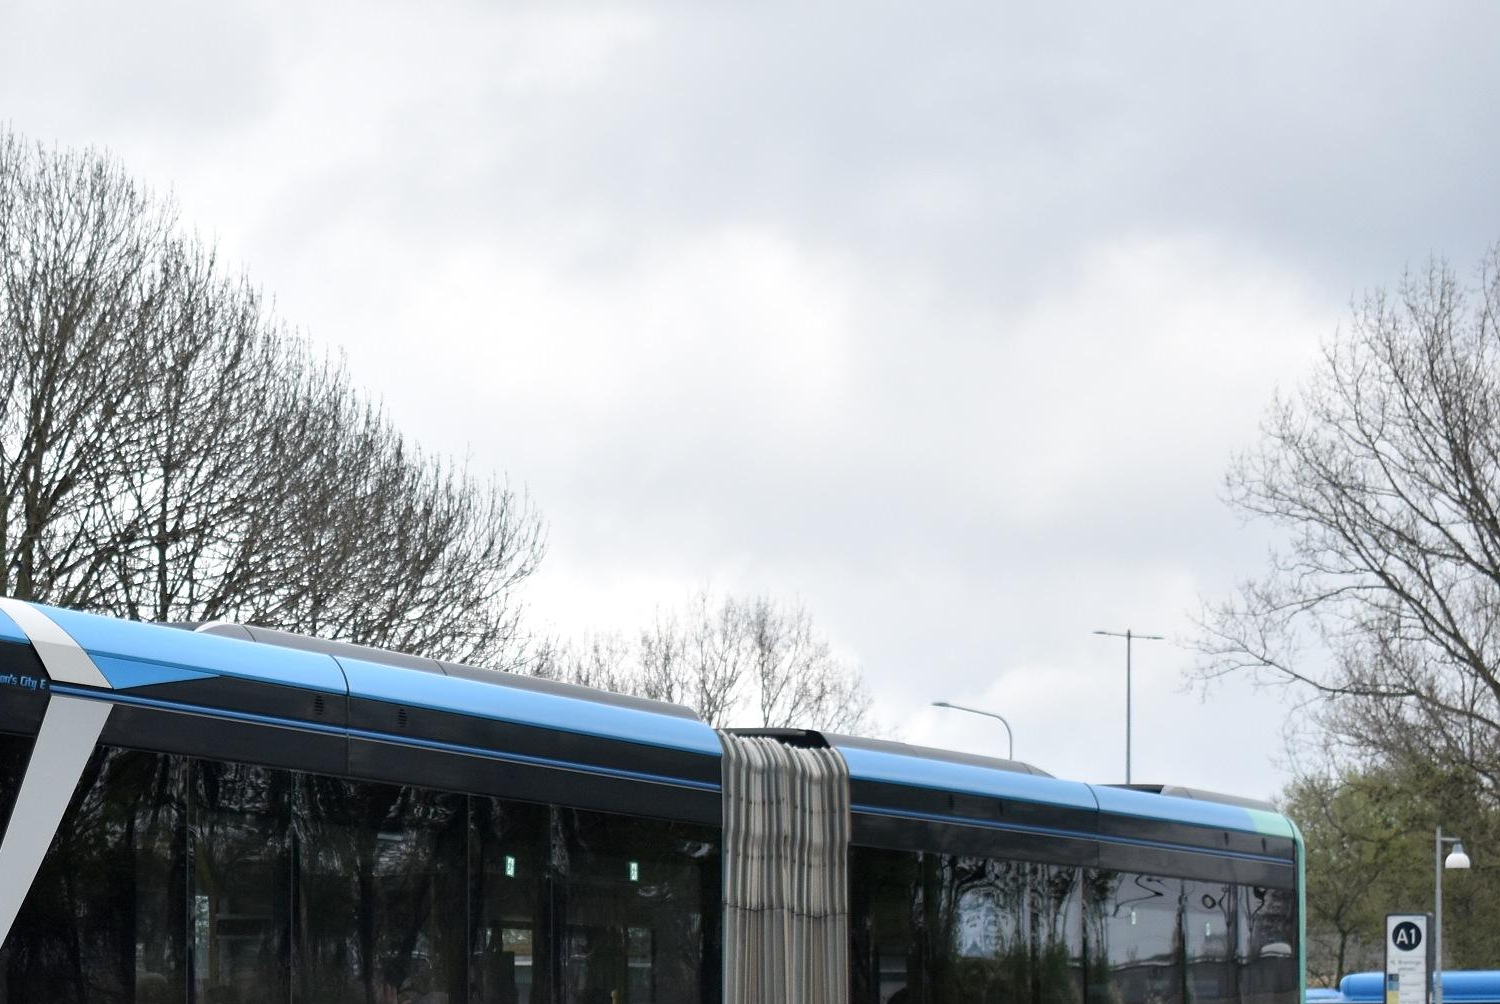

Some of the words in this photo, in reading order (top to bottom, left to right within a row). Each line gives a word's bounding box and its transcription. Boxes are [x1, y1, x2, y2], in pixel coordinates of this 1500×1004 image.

[20, 676, 37, 691] City
[39, 679, 47, 690] E
[1396, 928, 1416, 945] A1
